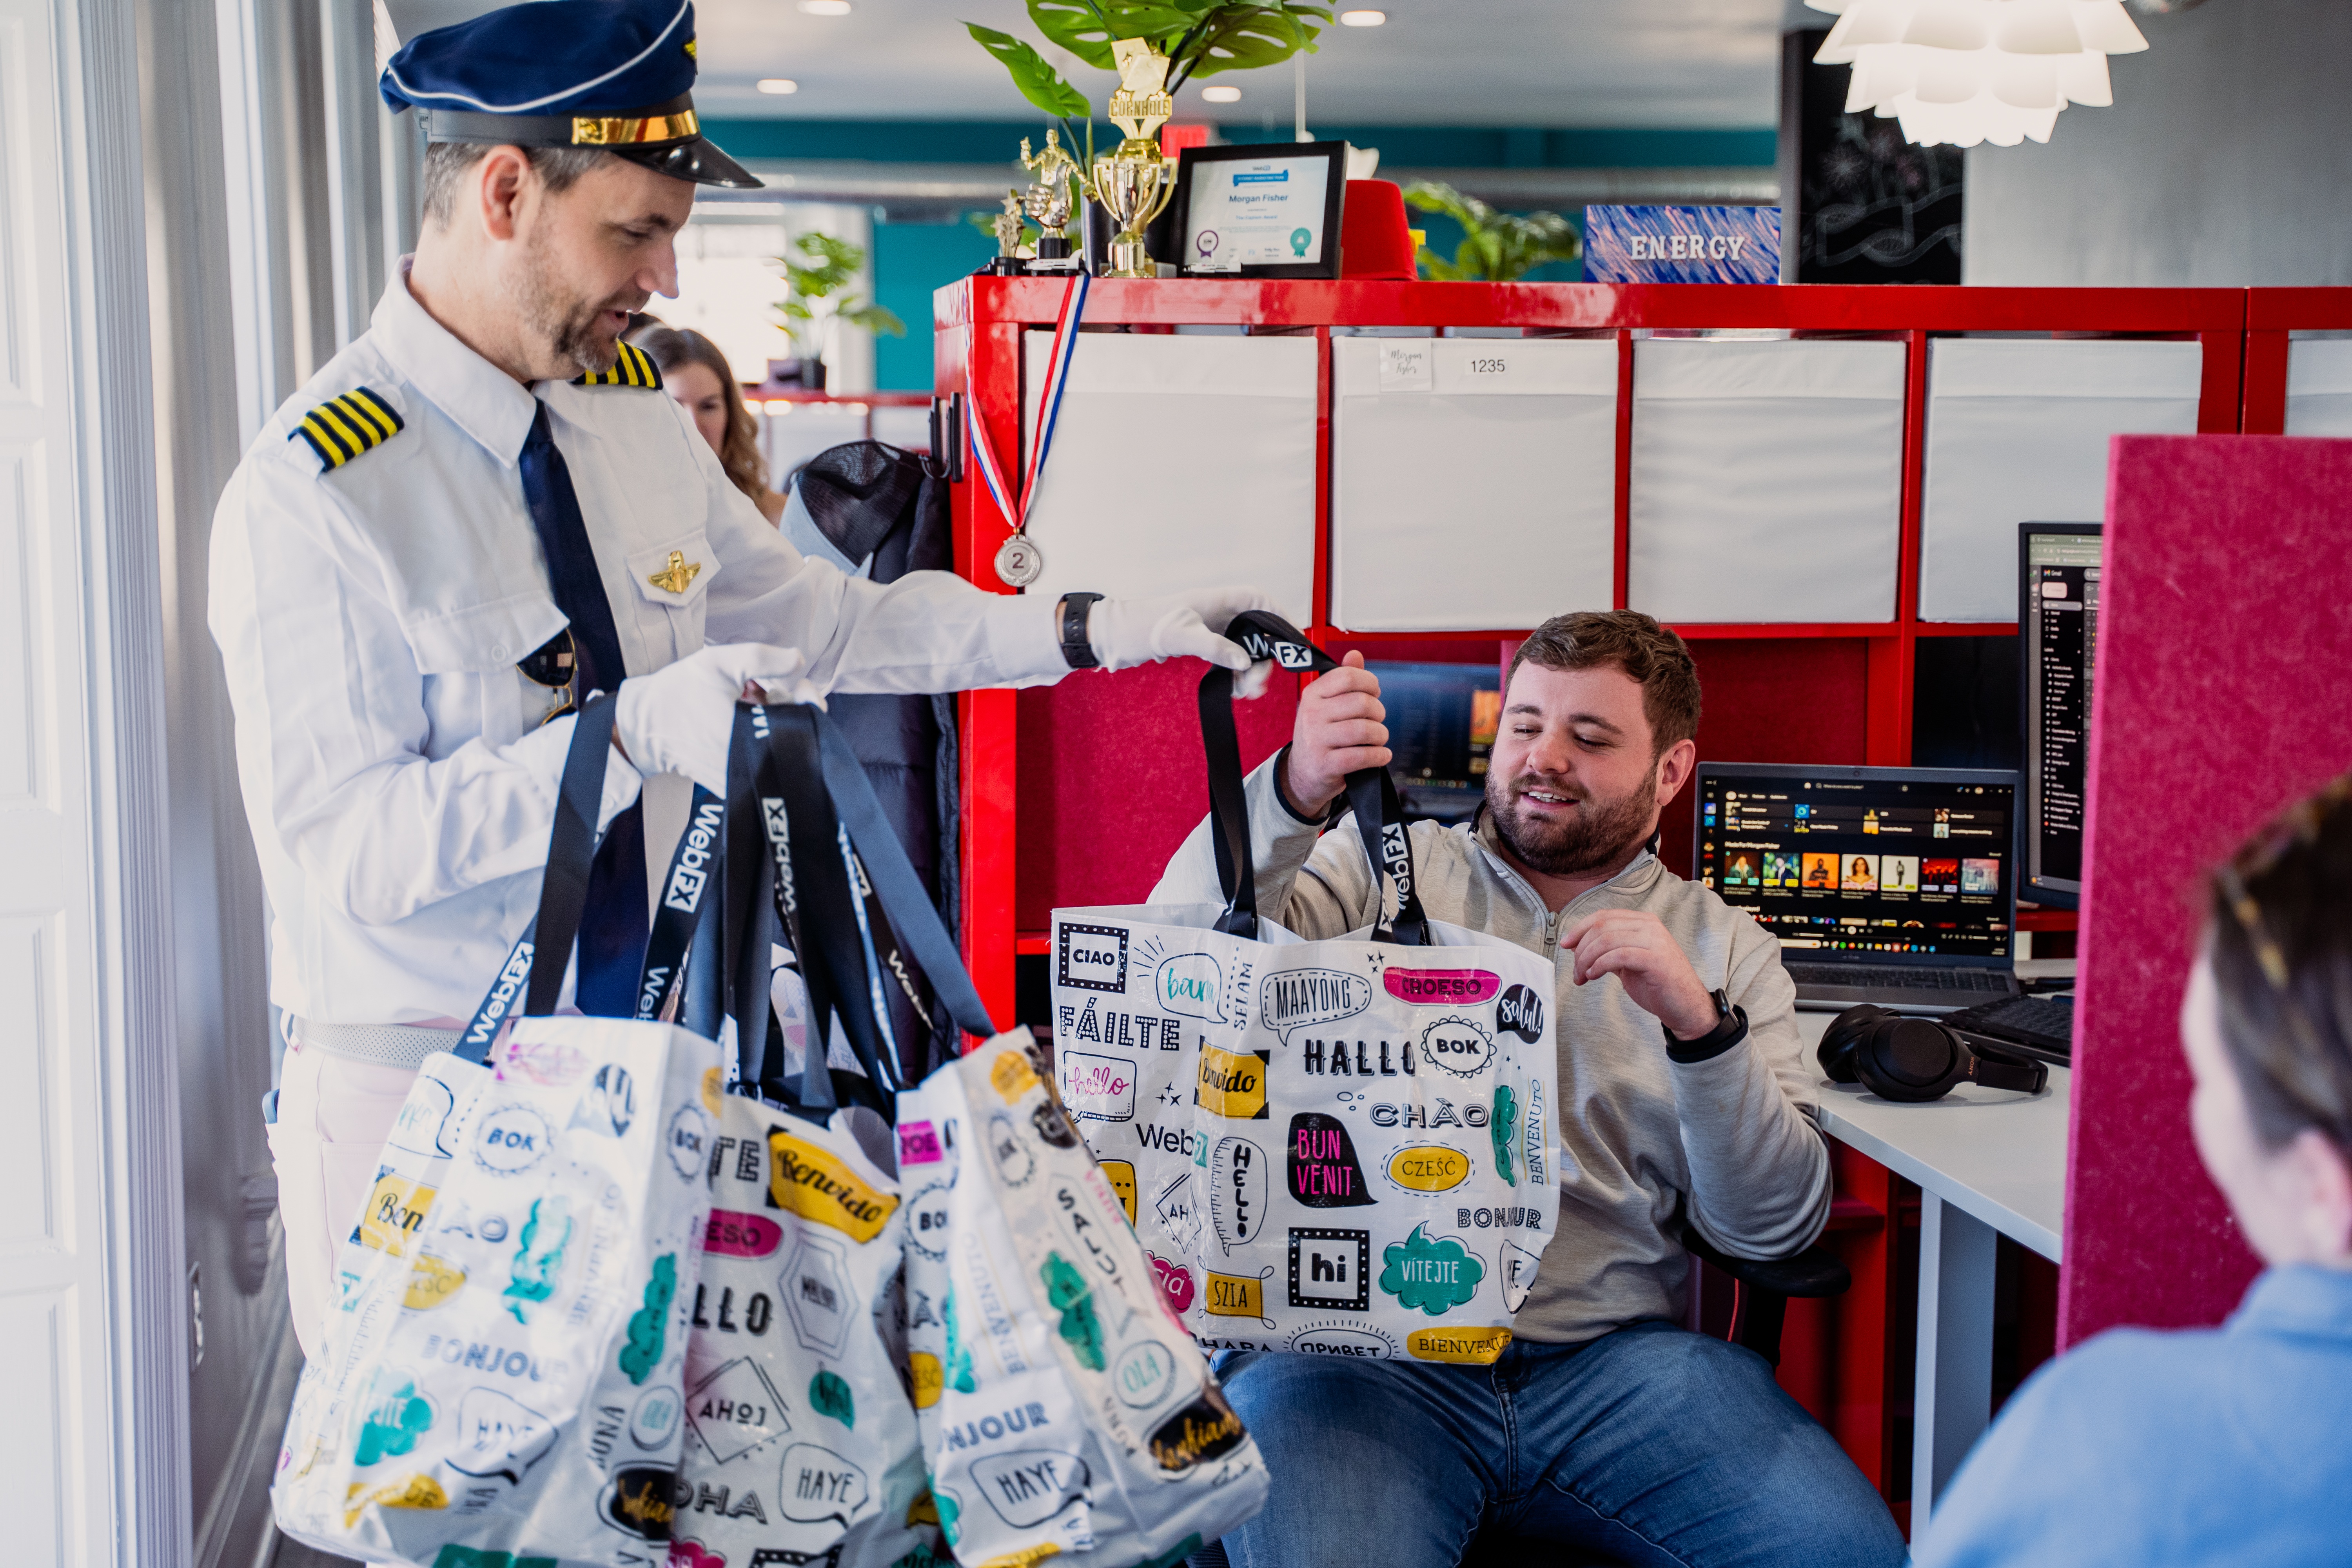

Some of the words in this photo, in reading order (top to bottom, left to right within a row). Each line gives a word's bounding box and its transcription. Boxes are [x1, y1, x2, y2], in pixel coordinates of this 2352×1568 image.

[1111, 101, 1169, 116] CORNHOLE
[1229, 195, 1261, 203] Morgan
[1262, 194, 1289, 202] Fisher
[1630, 234, 1746, 261] ENERGY
[1471, 359, 1505, 373] 1235
[1012, 552, 1024, 569] 2
[665, 804, 724, 913] WebFX
[1073, 949, 1115, 966] CIAO
[467, 942, 535, 1044] WebFX
[1234, 961, 1253, 1031] SELAM
[1276, 978, 1350, 1020] MAAYONG
[1402, 978, 1482, 996] CROESO
[1059, 997, 1180, 1051] FÁILTE
[1436, 1038, 1481, 1054] BOK
[1069, 1066, 1130, 1096] hello
[1370, 1098, 1489, 1129] CHÀO
[486, 1127, 535, 1152] BOK
[1135, 1123, 1209, 1169] WebFX
[1297, 1129, 1341, 1161] BUN
[1527, 1079, 1544, 1186] BENVENUTO
[1296, 1165, 1353, 1196] VENIT
[1402, 1156, 1456, 1177] CZEŚĆ
[776, 1148, 882, 1223] Benvido
[1233, 1144, 1252, 1238] HELLO
[1311, 1252, 1347, 1283] hi
[1401, 1257, 1459, 1284] VÍTEJTE
[1214, 1281, 1248, 1309] SZIA
[691, 1283, 773, 1338] LLO
[1300, 1342, 1381, 1357] ПРИВЕТ
[699, 1398, 766, 1426] AHOJ
[796, 1467, 855, 1508] HAYE
